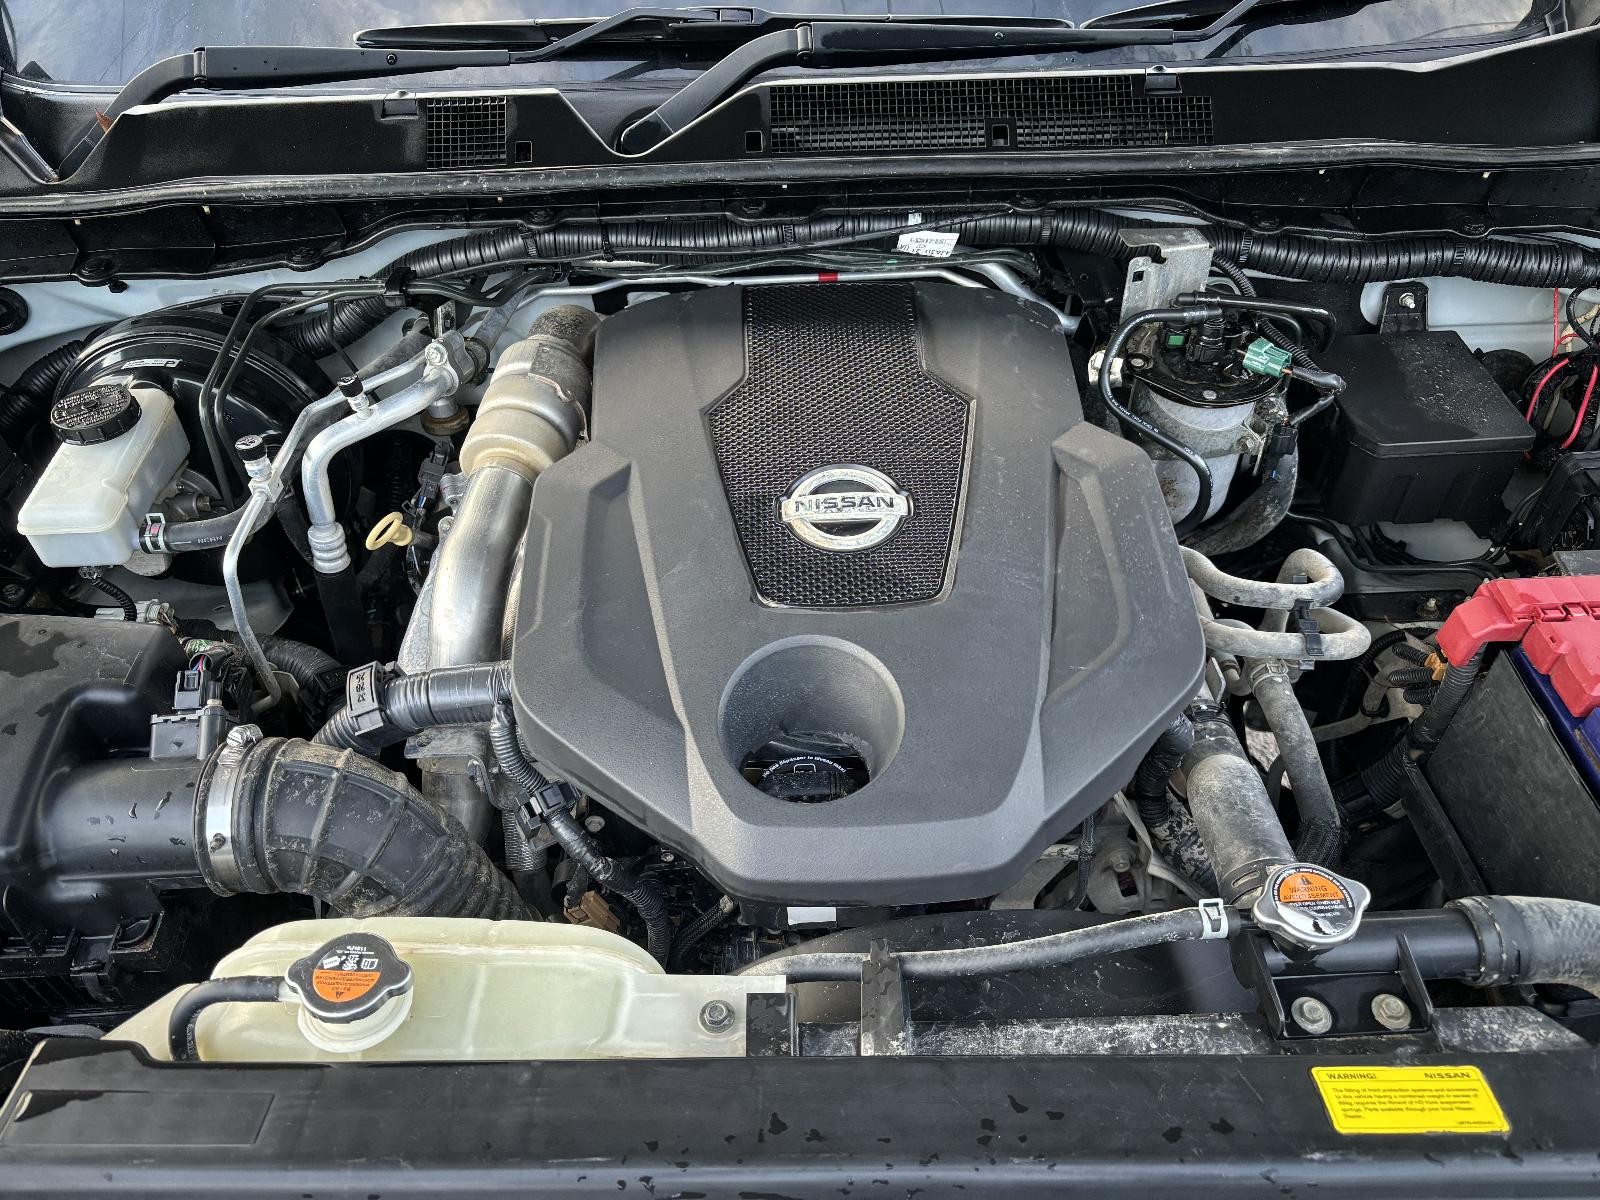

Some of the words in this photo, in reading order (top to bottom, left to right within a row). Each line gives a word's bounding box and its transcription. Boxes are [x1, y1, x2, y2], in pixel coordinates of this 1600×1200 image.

[795, 496, 894, 512] NISSAN
[1289, 885, 1328, 893] WARNING
[1326, 1072, 1376, 1080] WARNING!
